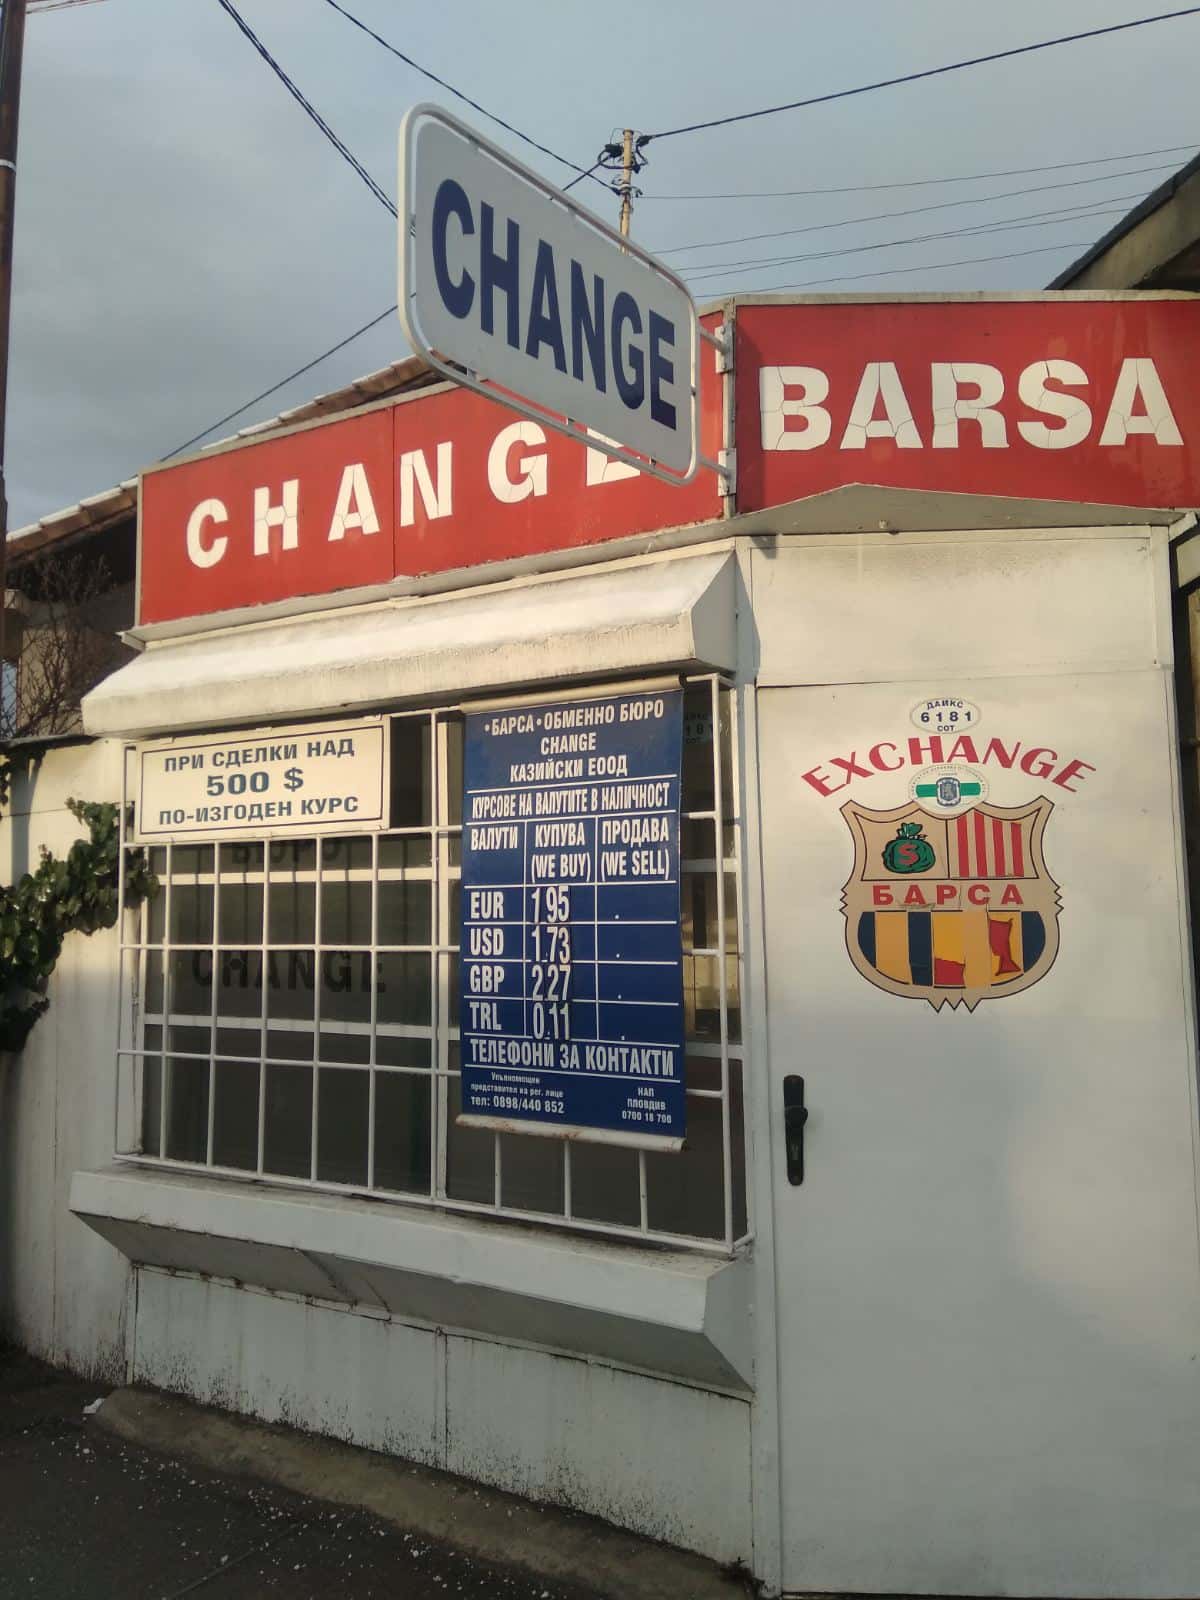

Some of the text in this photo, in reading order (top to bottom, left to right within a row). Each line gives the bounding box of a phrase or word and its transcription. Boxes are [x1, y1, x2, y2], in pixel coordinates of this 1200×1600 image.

[431, 178, 677, 431] CHANGE
[759, 357, 1185, 451] BARSA
[544, 705, 615, 731] ОБМЕННО
[619, 699, 664, 722] БЮРО
[920, 711, 972, 723] 6181
[164, 738, 355, 772] ПРИ СДЕЛКИ НАД
[540, 732, 597, 755] CHANGE
[510, 755, 628, 783] КАЗИЙСКИ ЕООД
[801, 735, 1097, 798] EXCHANGE
[206, 767, 304, 796] 500 $
[159, 796, 359, 825] ПО-ИЗГОДЕН КУРС
[472, 782, 670, 819] КУРСОВЕ НА ВАЛУТИТЕ В НАЛИЧНОСТ
[471, 826, 518, 851] ВАЛУТИ
[535, 822, 585, 848] КУПУВА
[602, 817, 669, 847] ПРОДАВА
[531, 852, 591, 883] (WE BUY)
[601, 849, 670, 881] (WE SELL)
[470, 891, 504, 919] EUR
[873, 884, 1024, 906] БАРСА
[470, 928, 504, 956] USD
[470, 965, 504, 993] GBP
[470, 1002, 502, 1030] TRL
[470, 1039, 674, 1076] ТЕЛЕФОНИ ЗА КОНТАКТИ
[493, 1095, 541, 1111] 0898/440
[544, 1100, 564, 1114] 852
[637, 1087, 655, 1097] НАП
